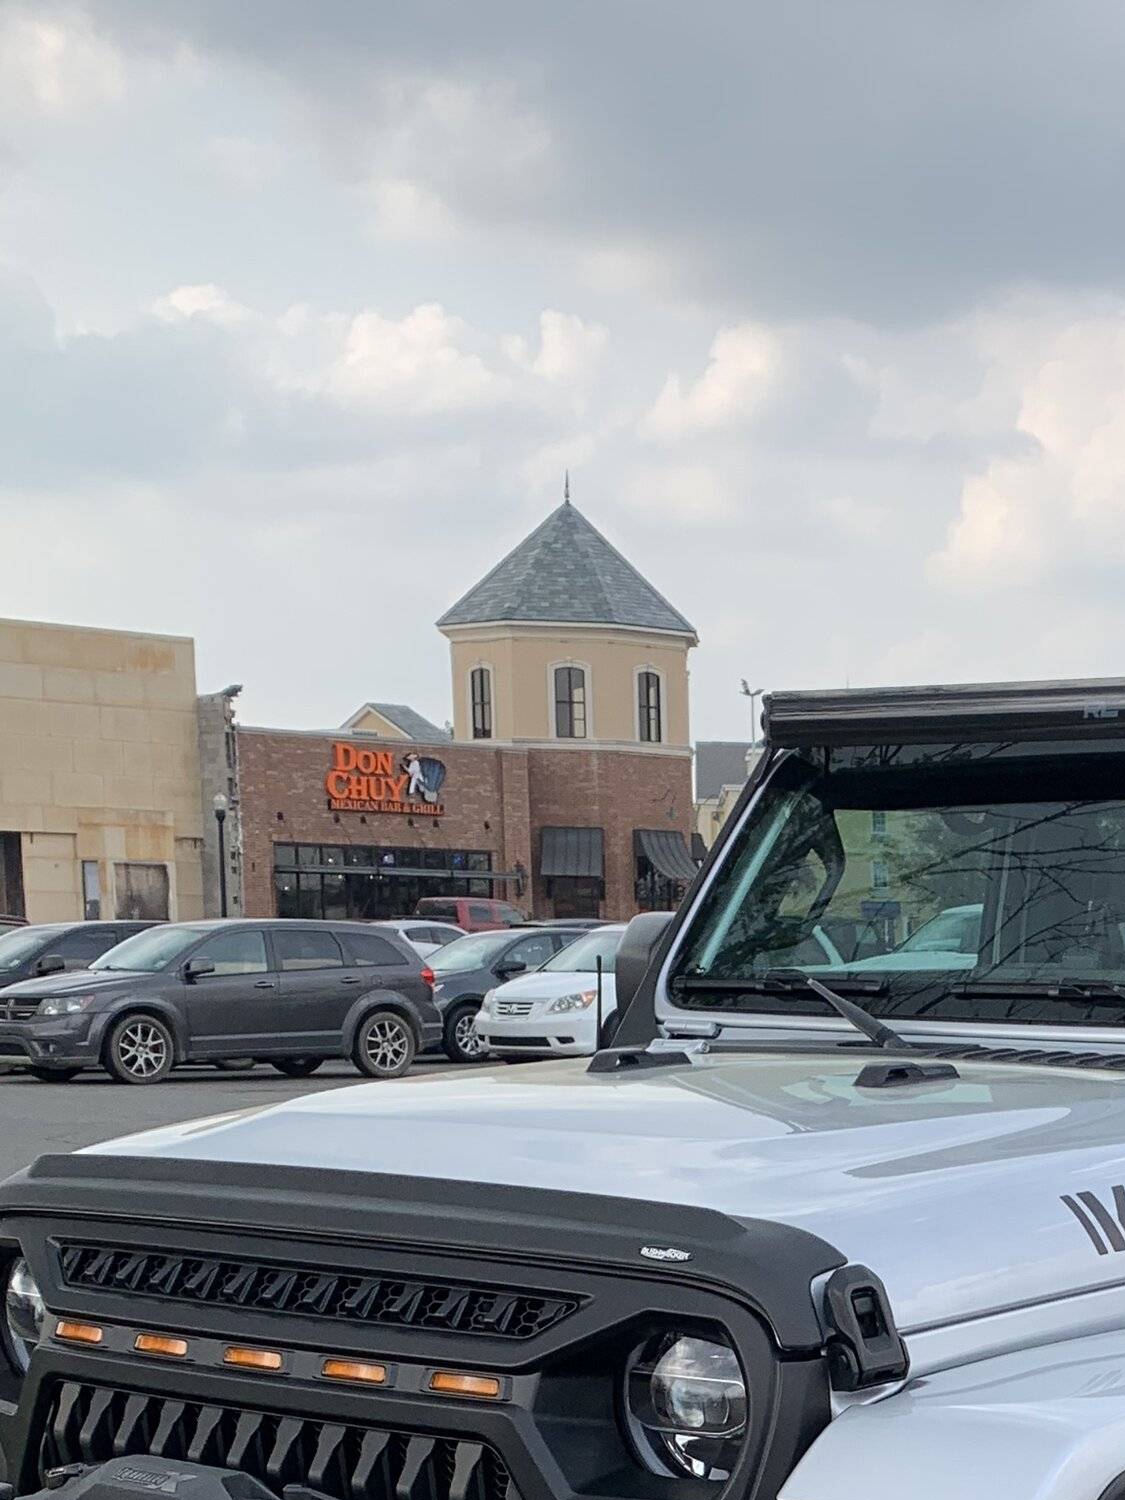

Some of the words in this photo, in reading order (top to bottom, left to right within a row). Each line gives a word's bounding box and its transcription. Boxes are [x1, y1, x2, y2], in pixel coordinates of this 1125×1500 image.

[334, 742, 393, 775] DON
[326, 771, 409, 802] CHUY
[331, 799, 379, 812] MEXICAN
[381, 801, 401, 812] BAR
[412, 803, 443, 815] GRILL
